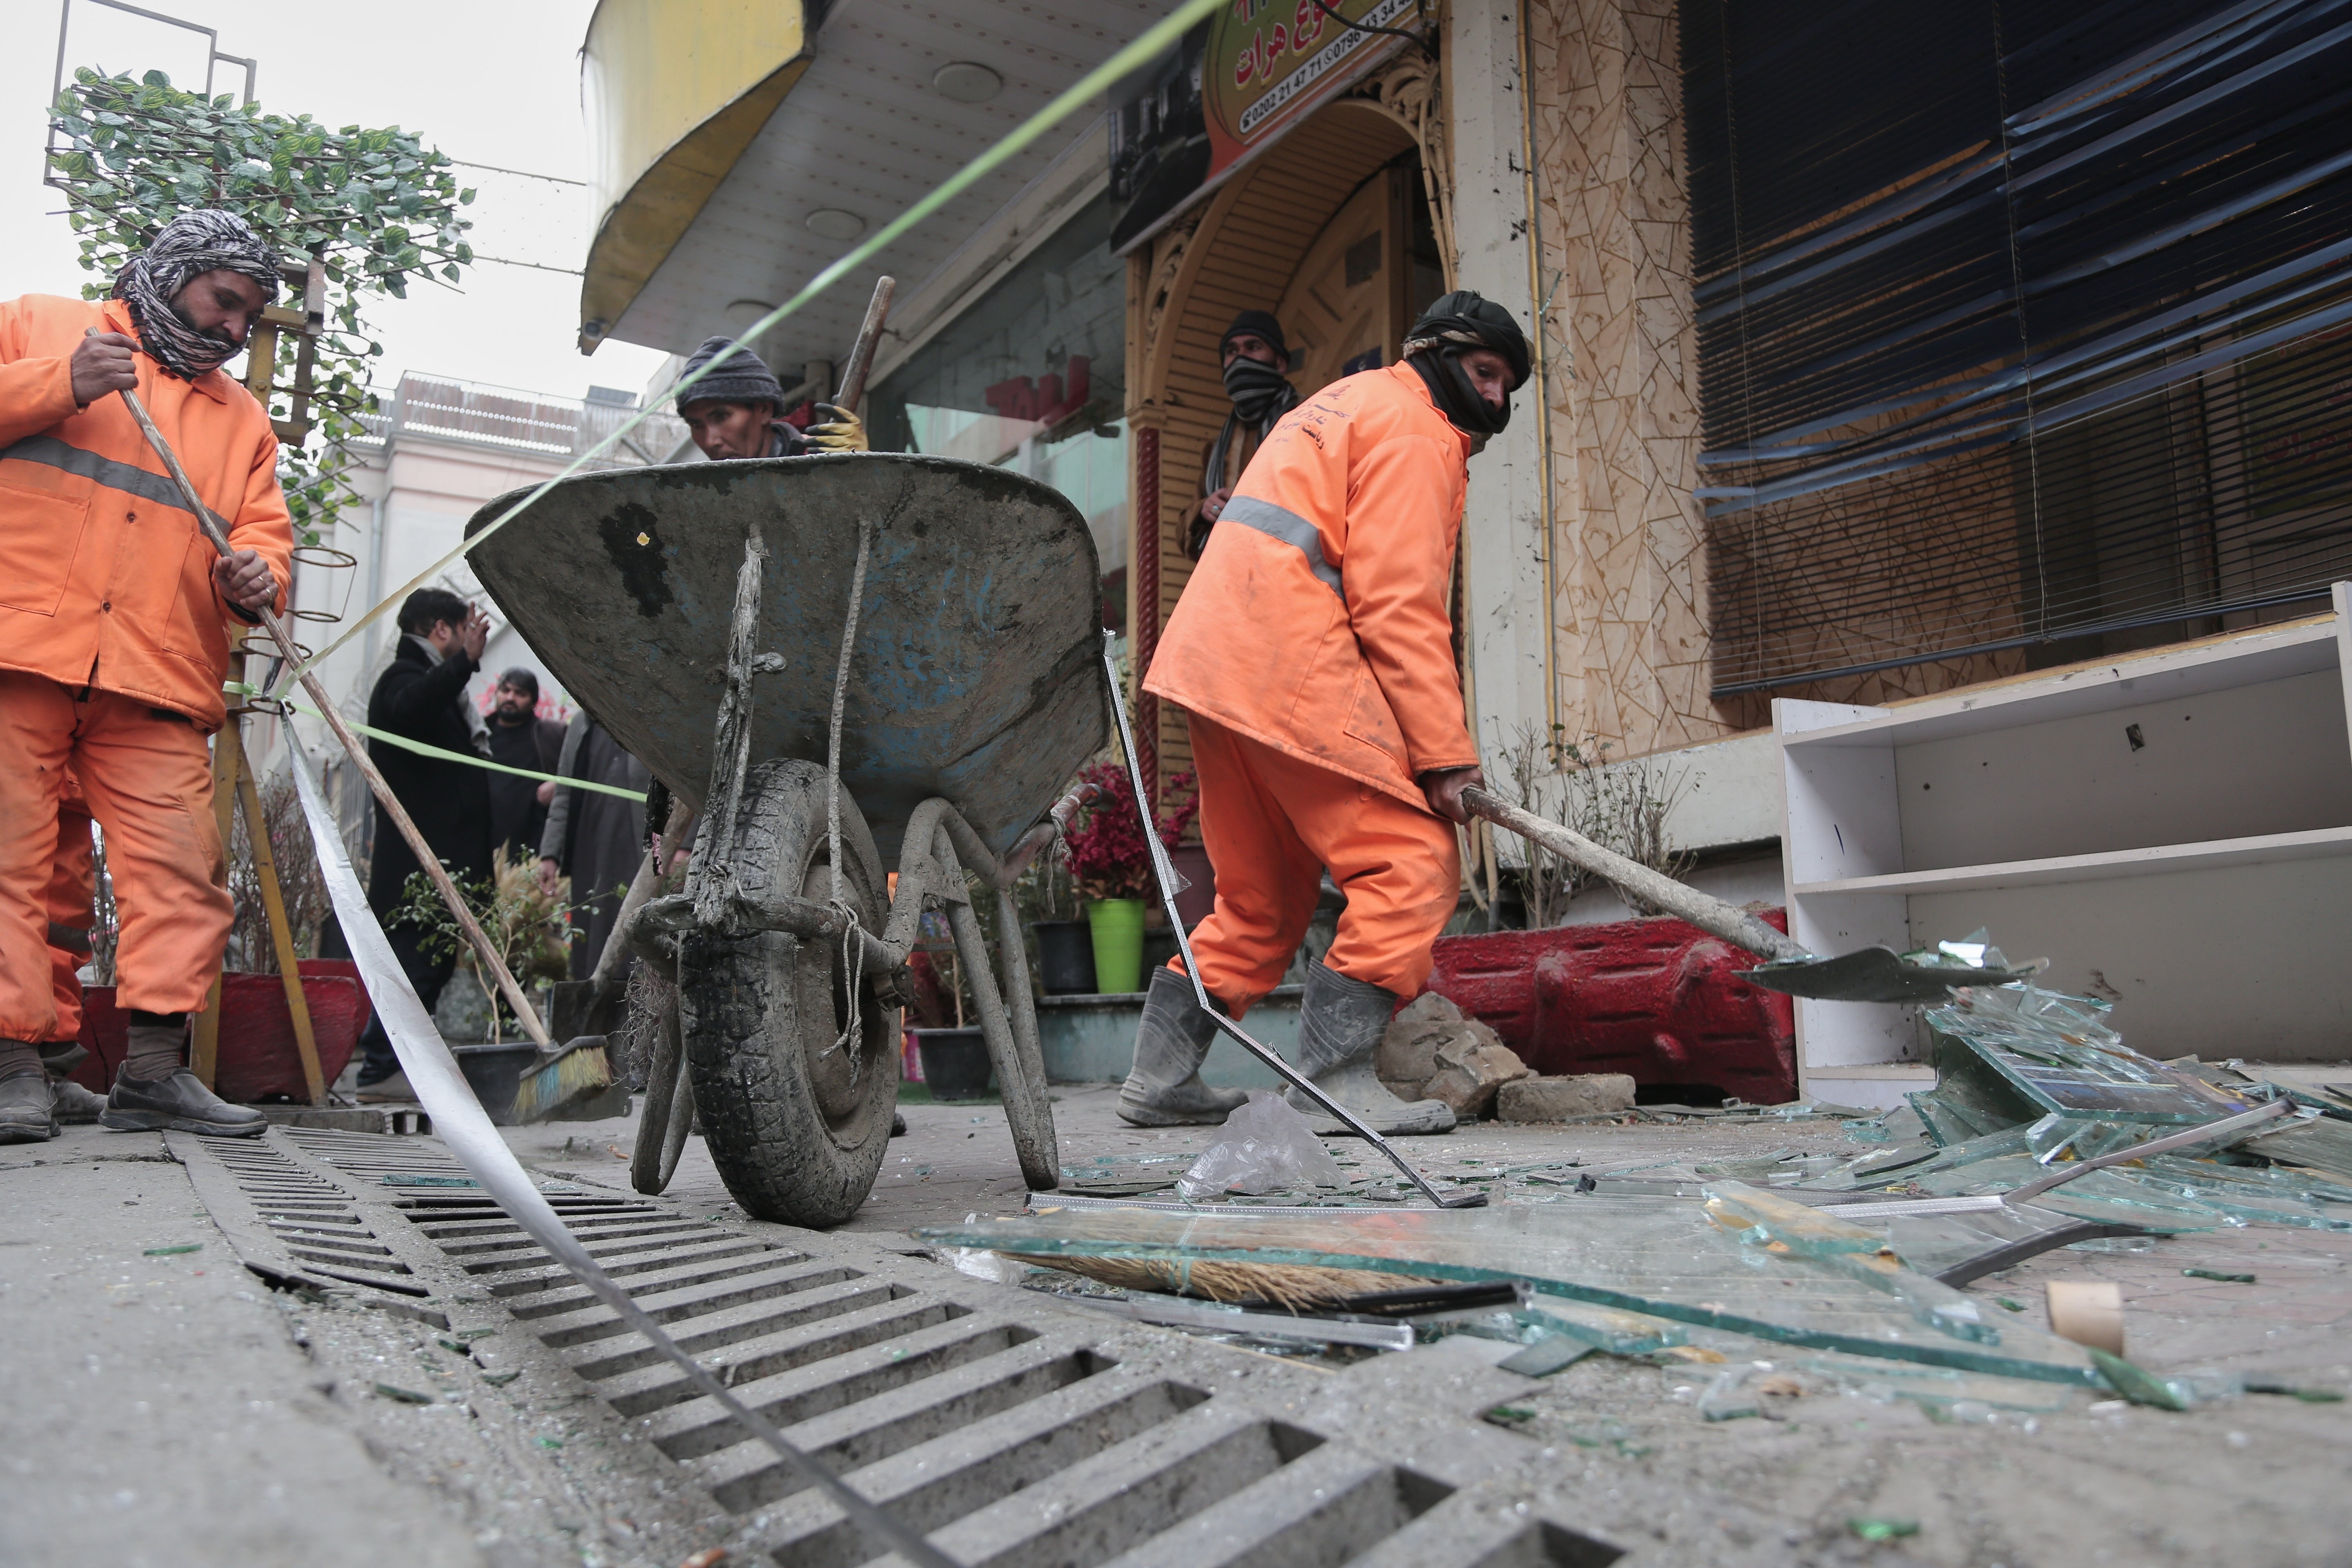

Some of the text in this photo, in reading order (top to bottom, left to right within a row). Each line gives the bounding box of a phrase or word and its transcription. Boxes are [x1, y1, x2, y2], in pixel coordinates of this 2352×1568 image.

[1235, 22, 1287, 86] هرات
[1252, 93, 1276, 121] 0202
[1278, 81, 1290, 101] 21
[1294, 68, 1306, 87] 47
[1309, 57, 1321, 76] 71
[1334, 31, 1361, 58] 0796
